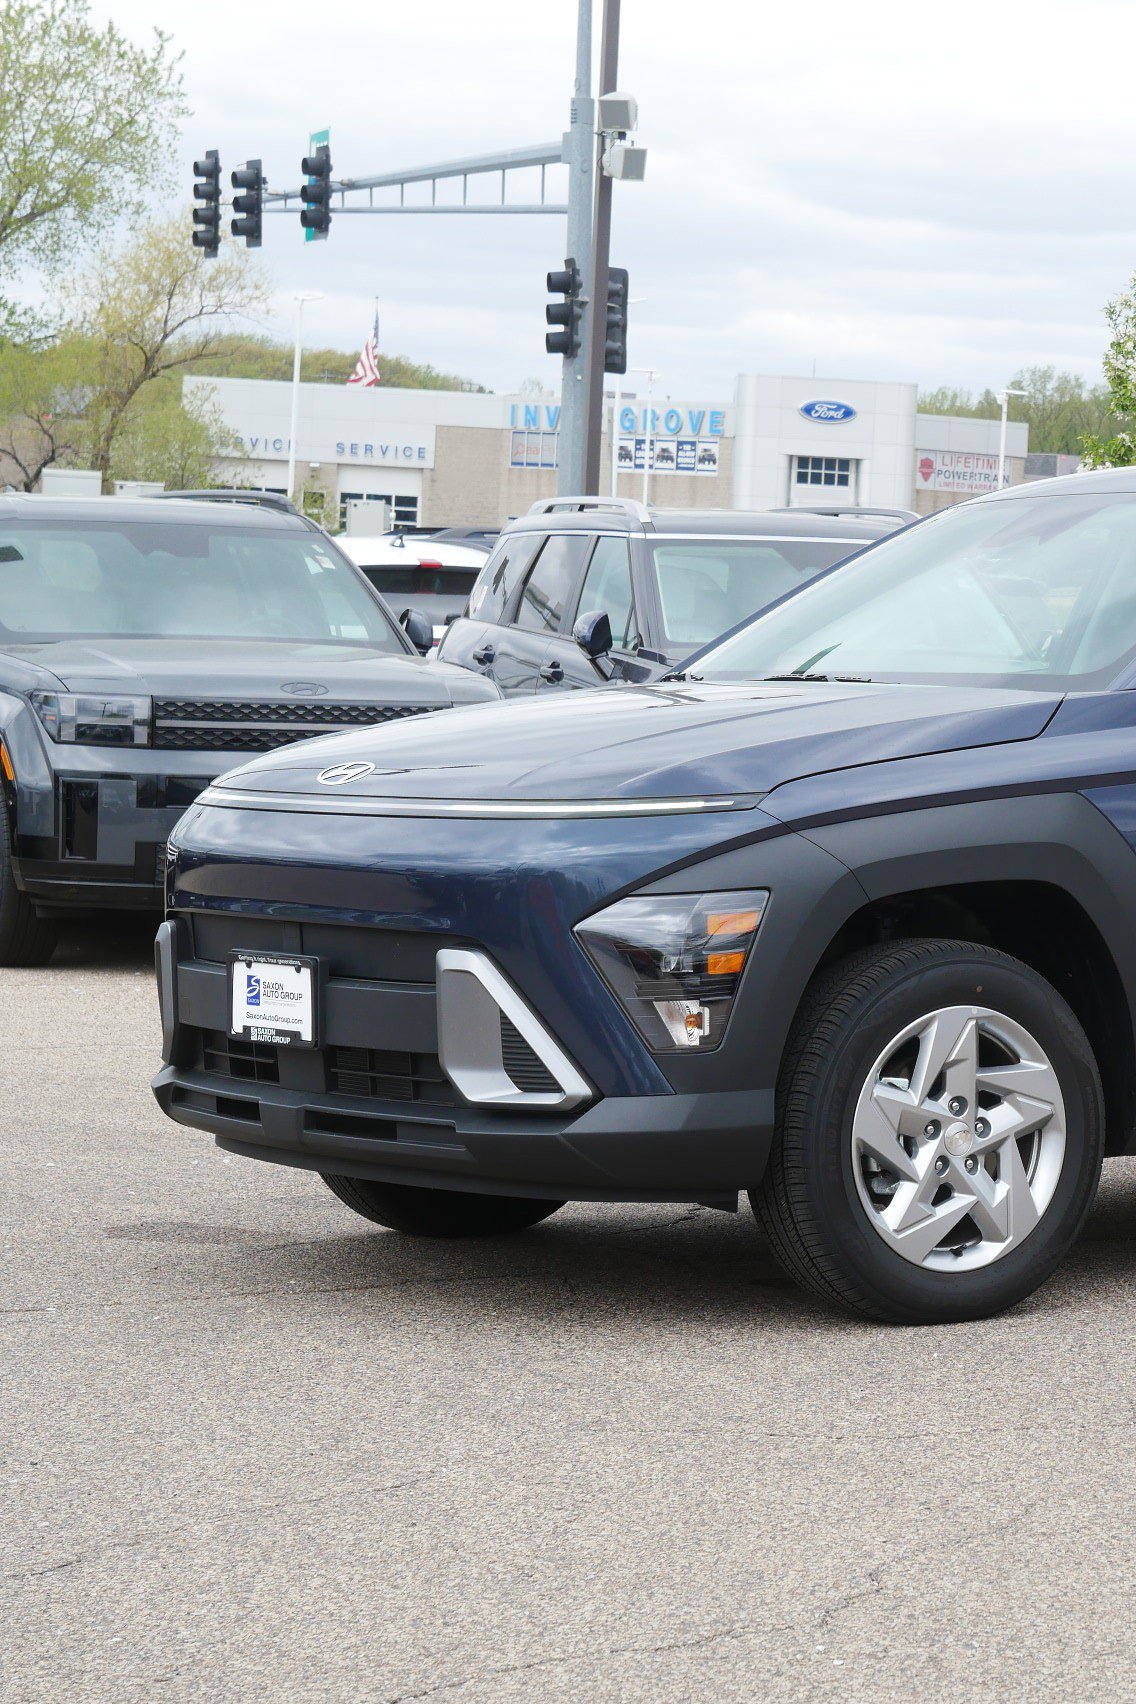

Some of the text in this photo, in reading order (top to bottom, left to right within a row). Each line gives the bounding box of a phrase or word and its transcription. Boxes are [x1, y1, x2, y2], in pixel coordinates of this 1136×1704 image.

[811, 403, 846, 419] Ford
[510, 404, 725, 435] INV GROVE
[336, 442, 426, 459] SERVICE
[942, 455, 1000, 471] LIFETIM
[937, 469, 1010, 484] POWERTRAN
[262, 981, 284, 991] SAXON
[262, 989, 303, 1001] AUTO GROUP
[246, 1011, 303, 1025] SaxonAutoGroup.com
[257, 1027, 276, 1036] SAXON
[257, 1034, 291, 1044] AUTO GROUP
